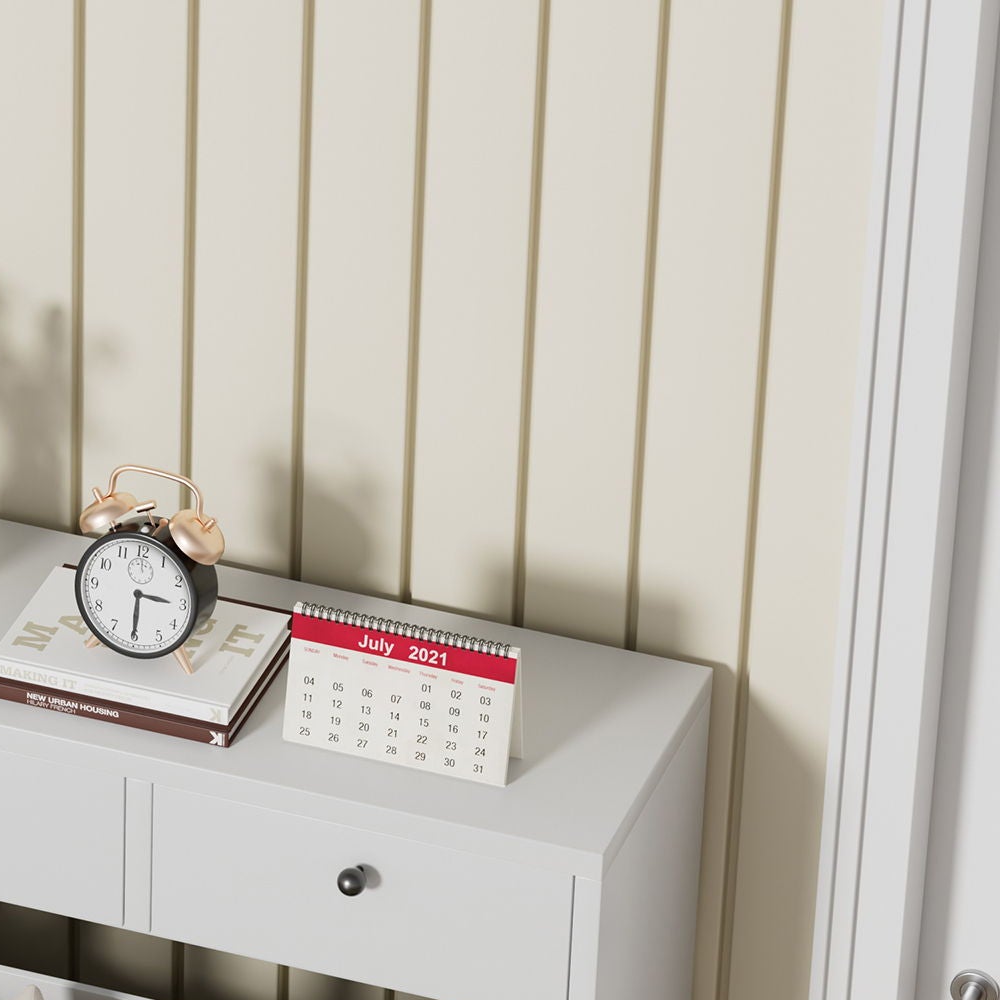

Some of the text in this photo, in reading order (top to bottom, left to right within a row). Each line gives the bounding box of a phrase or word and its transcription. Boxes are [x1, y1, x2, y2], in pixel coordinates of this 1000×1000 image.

[118, 546, 128, 559] 11
[138, 545, 149, 558] 12
[100, 557, 112, 572] 10
[91, 576, 99, 589] 9
[175, 575, 183, 588] 2
[95, 599, 103, 612] 8
[179, 599, 187, 611] 3
[111, 618, 119, 631] 7
[169, 619, 177, 630] 4
[156, 630, 163, 642] 5
[358, 634, 447, 667] July 2021
[0, 665, 77, 689] MAKING IT
[304, 676, 490, 723] 04 05 06 07 08 09 10
[421, 683, 491, 706] 01 02 03
[26, 692, 120, 718] NEW URBAN HOUSING
[26, 699, 76, 714] HILARY FRENCH
[304, 693, 488, 740] 11 12 13 14 15 16 17
[302, 710, 485, 757] 18 19 20 21 22 23 24
[299, 726, 483, 773] 25 26 27 28 29 30 31
